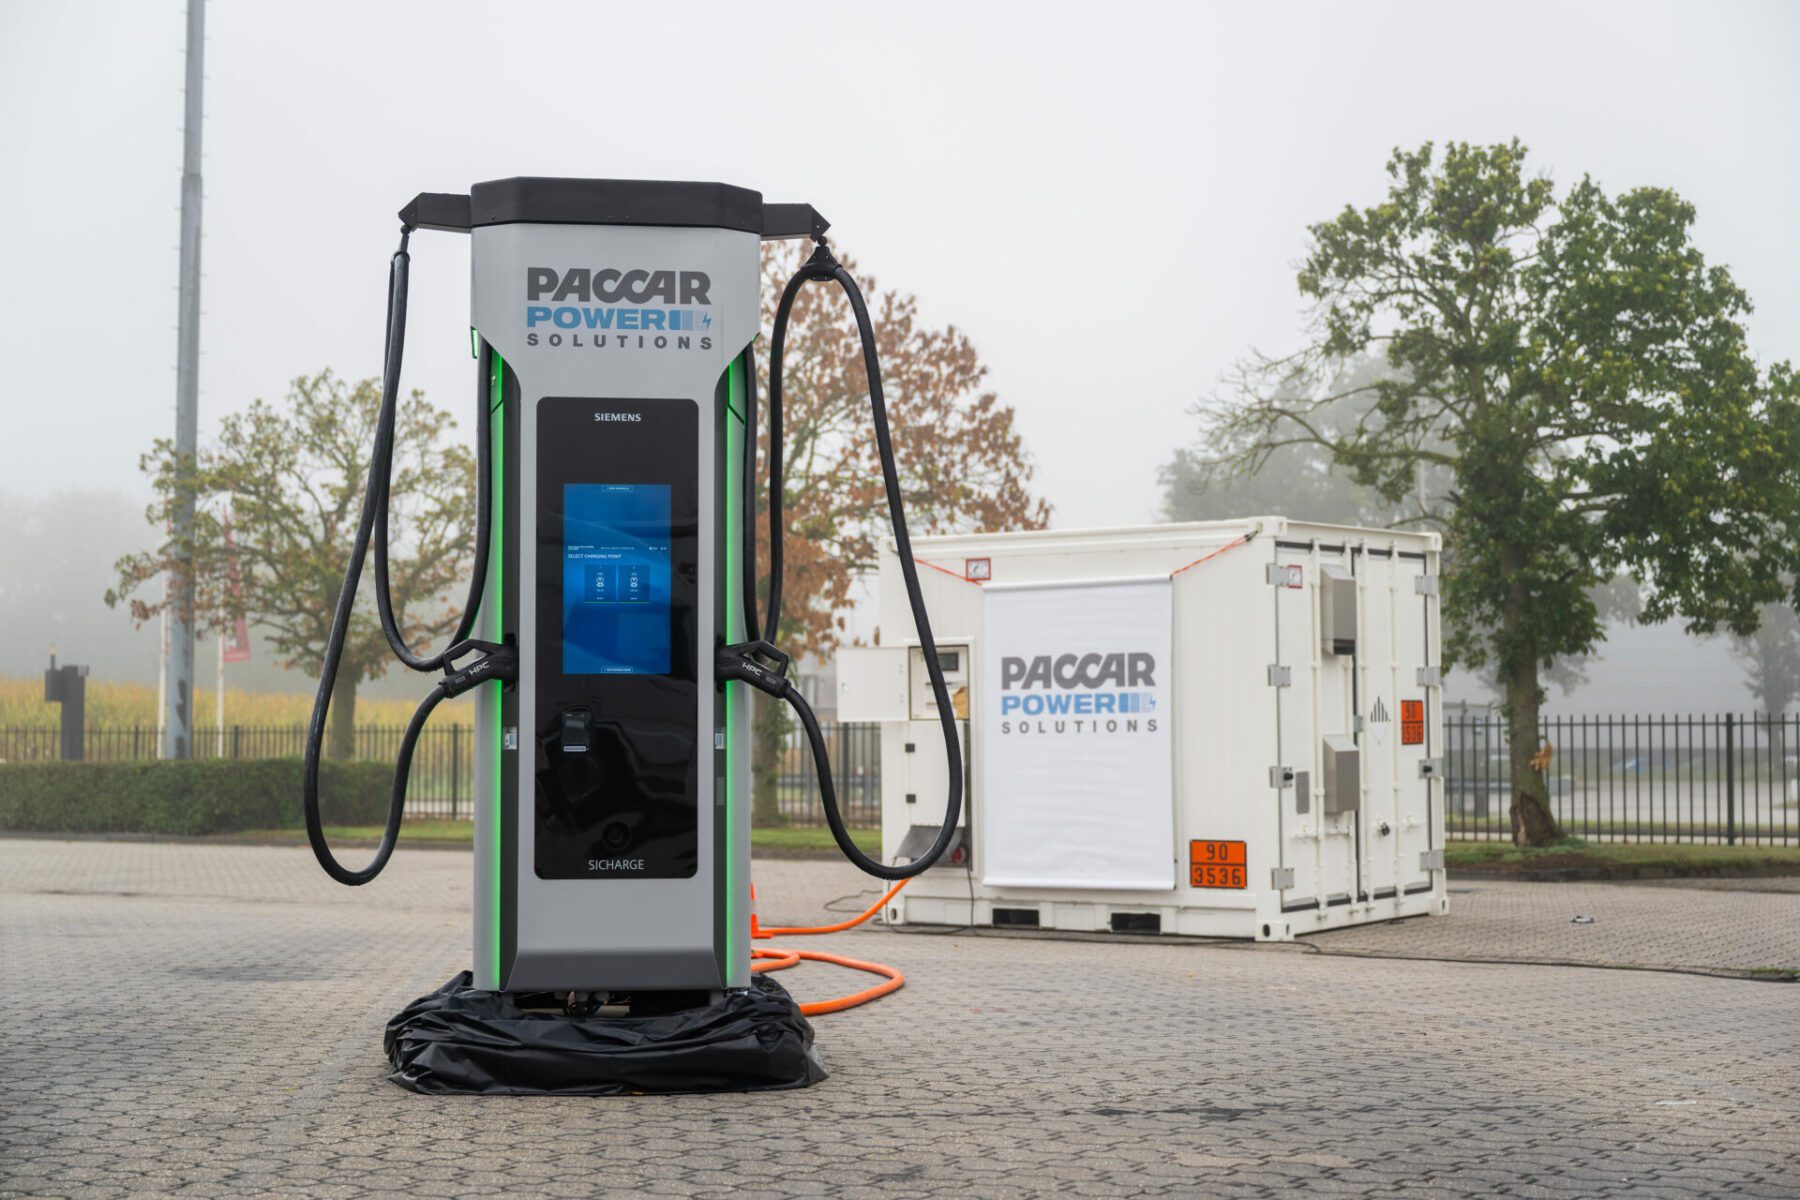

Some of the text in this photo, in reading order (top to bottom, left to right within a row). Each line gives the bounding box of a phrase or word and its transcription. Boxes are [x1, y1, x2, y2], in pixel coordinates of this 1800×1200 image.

[527, 267, 712, 305] PACCAR
[527, 306, 666, 331] POWER
[527, 333, 712, 350] SOLUTIONS
[594, 412, 642, 422] SIEMENS
[468, 661, 490, 676] HPC
[741, 661, 764, 677] HPC
[1001, 652, 1156, 690] PACCAR
[1001, 692, 1116, 716] POWER
[1002, 719, 1158, 734] SOLUTIONS
[1206, 843, 1228, 861] 90
[588, 859, 645, 870] SICHARGE
[1194, 866, 1241, 886] 3536
